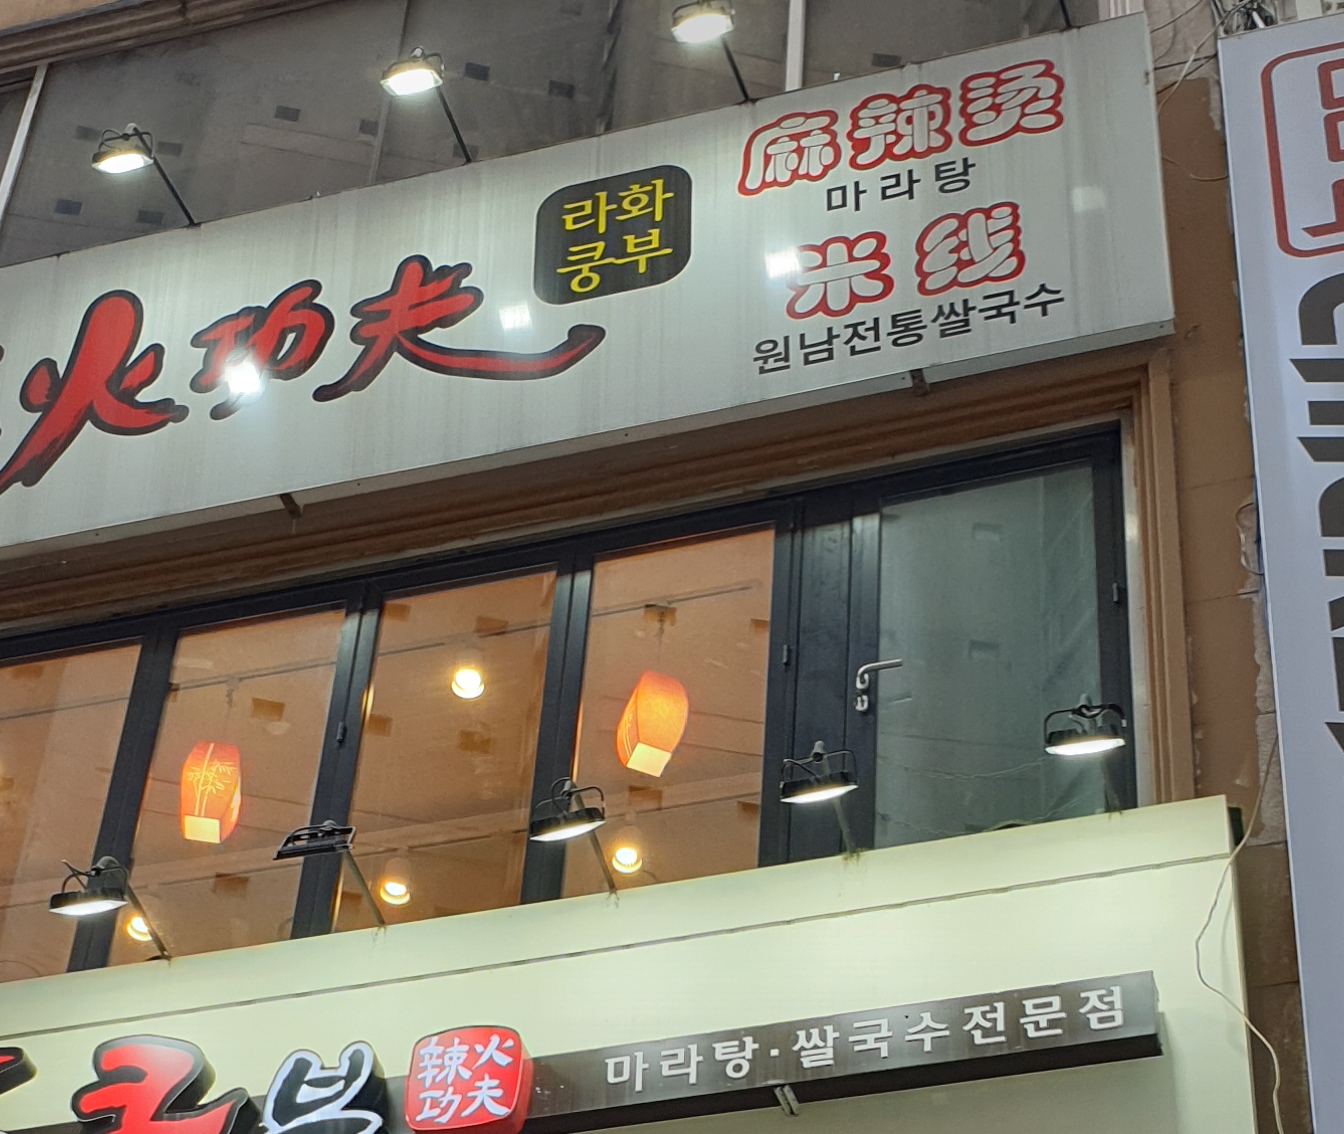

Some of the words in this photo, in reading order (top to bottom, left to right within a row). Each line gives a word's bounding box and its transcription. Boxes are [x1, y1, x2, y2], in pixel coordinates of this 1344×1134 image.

[737, 59, 1065, 197] 麻辣烫
[561, 177, 676, 235] 라화
[826, 157, 976, 212] 마라탕
[554, 228, 674, 294] 쿵부
[786, 201, 1027, 321] 米线
[753, 283, 1065, 375] 원남전통쌀국수
